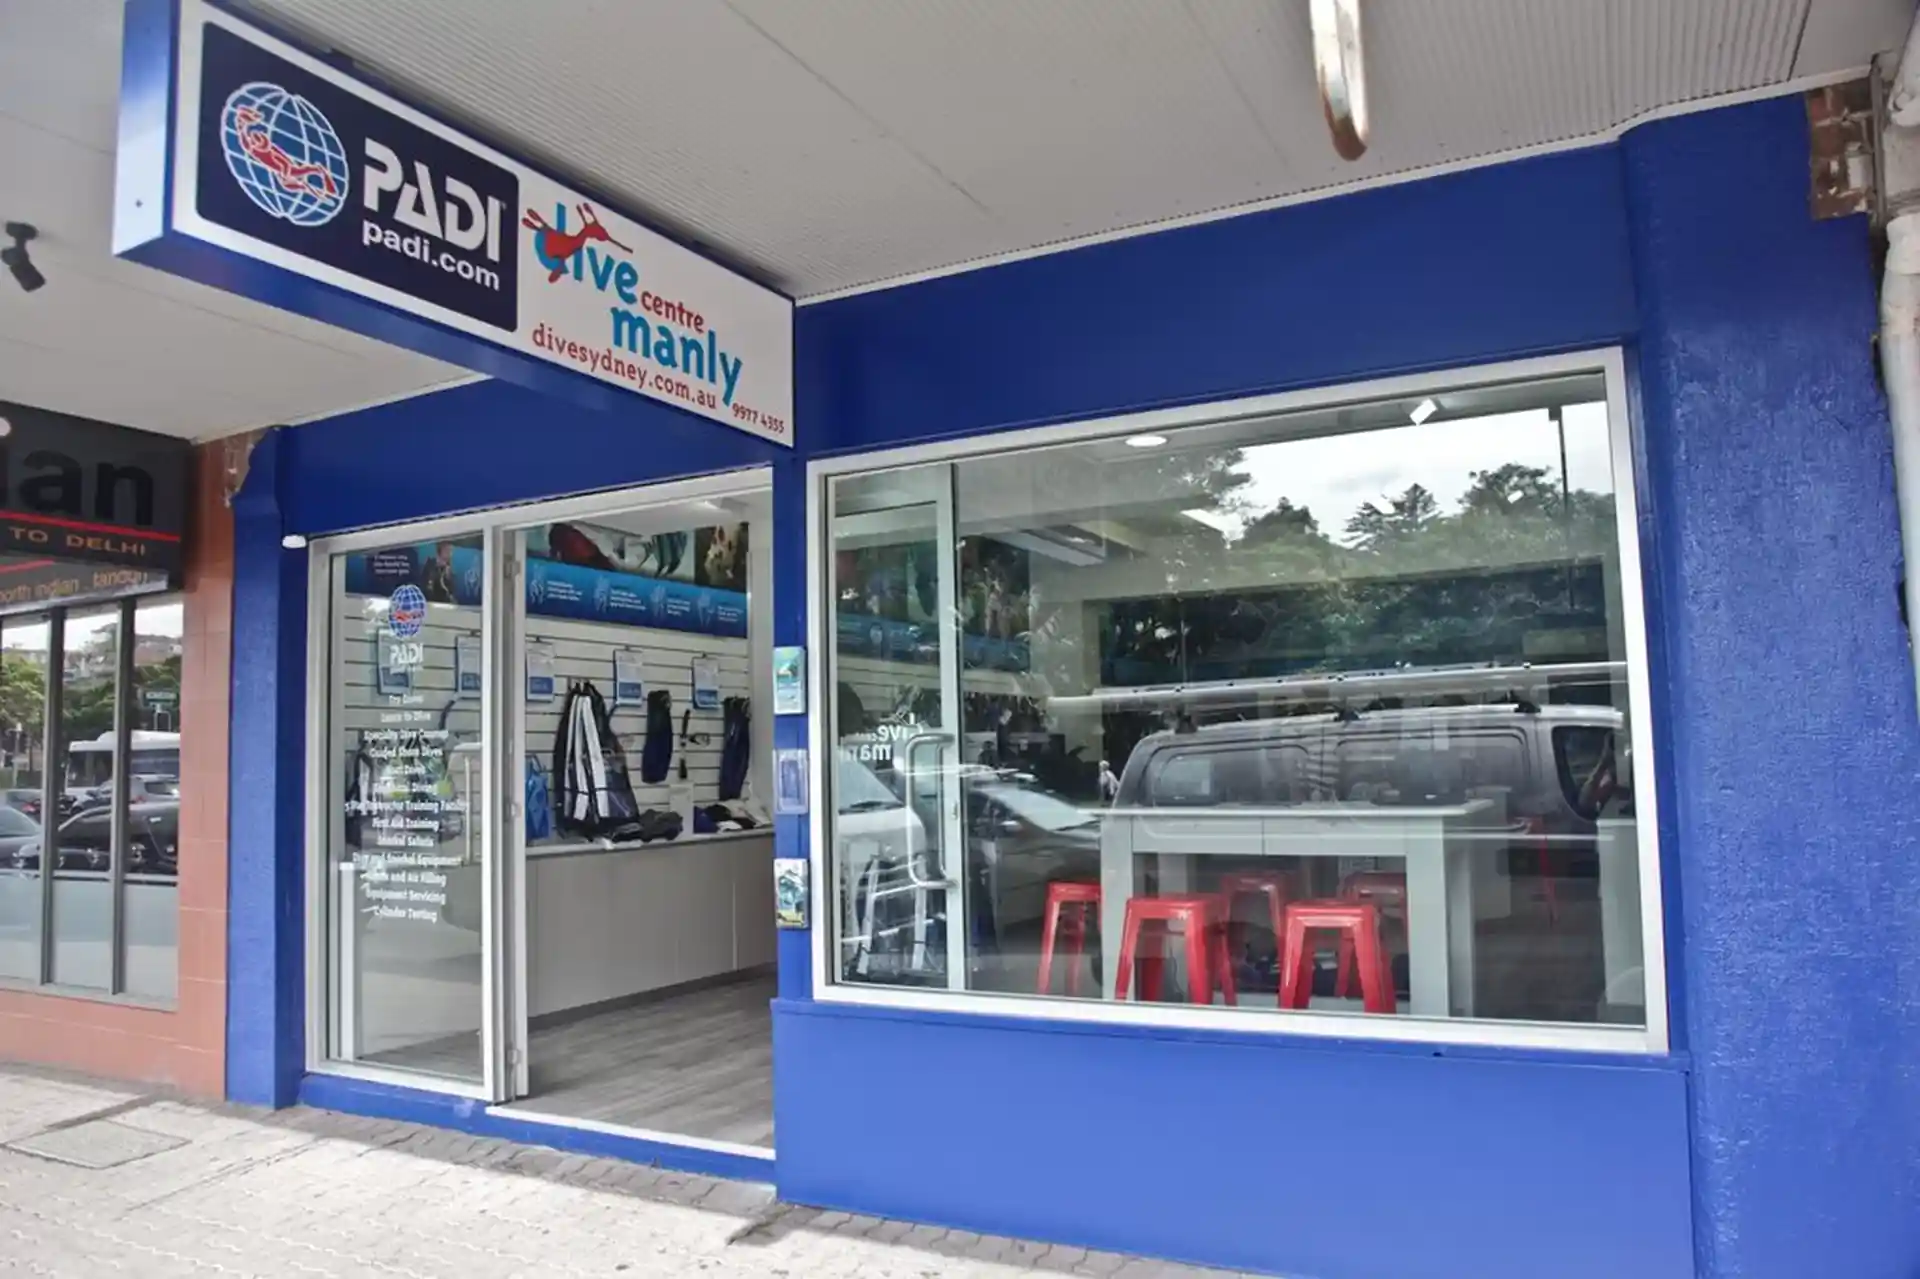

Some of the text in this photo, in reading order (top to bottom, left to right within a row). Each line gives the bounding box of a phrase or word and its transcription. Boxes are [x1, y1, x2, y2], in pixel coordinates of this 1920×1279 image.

[363, 136, 501, 263] PADI
[362, 219, 500, 291] padi.com
[641, 289, 705, 334] centre
[532, 322, 717, 411] divesydney.com.au
[610, 306, 744, 407] manly
[732, 402, 758, 424] 9977
[9, 527, 147, 556] TO DELHI
